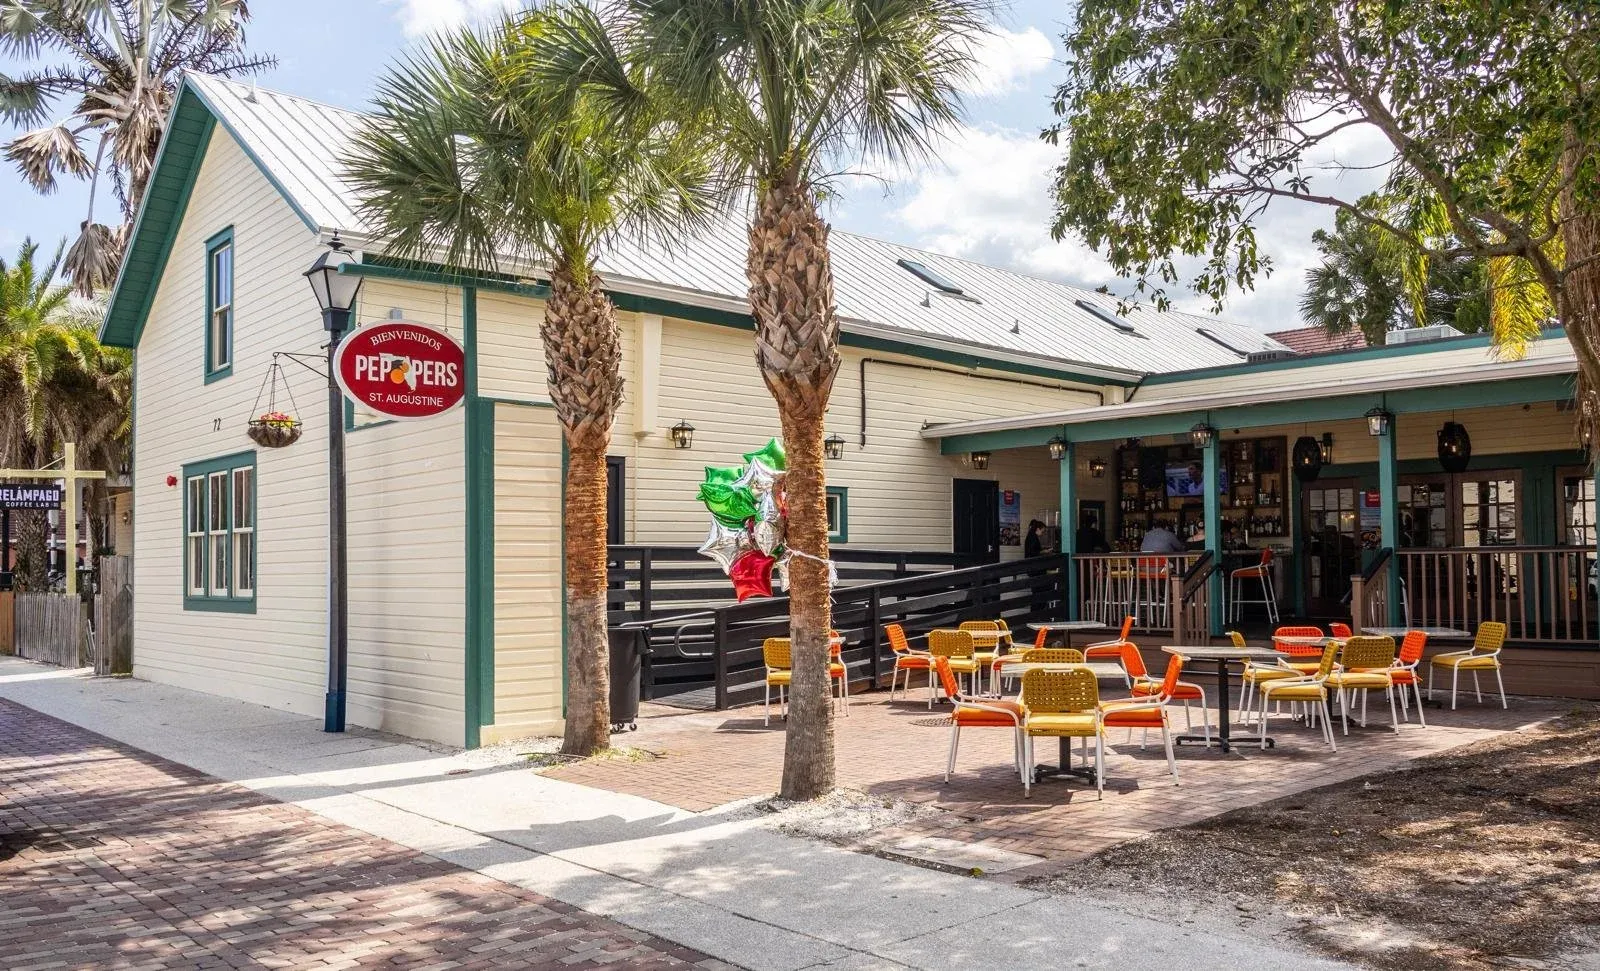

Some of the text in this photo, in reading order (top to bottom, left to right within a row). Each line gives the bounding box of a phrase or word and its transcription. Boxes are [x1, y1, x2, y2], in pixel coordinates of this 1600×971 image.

[371, 330, 442, 351] BIENVENIDOS
[355, 352, 458, 387] PEPPERS
[369, 392, 444, 407] ST. AUGUSTINE
